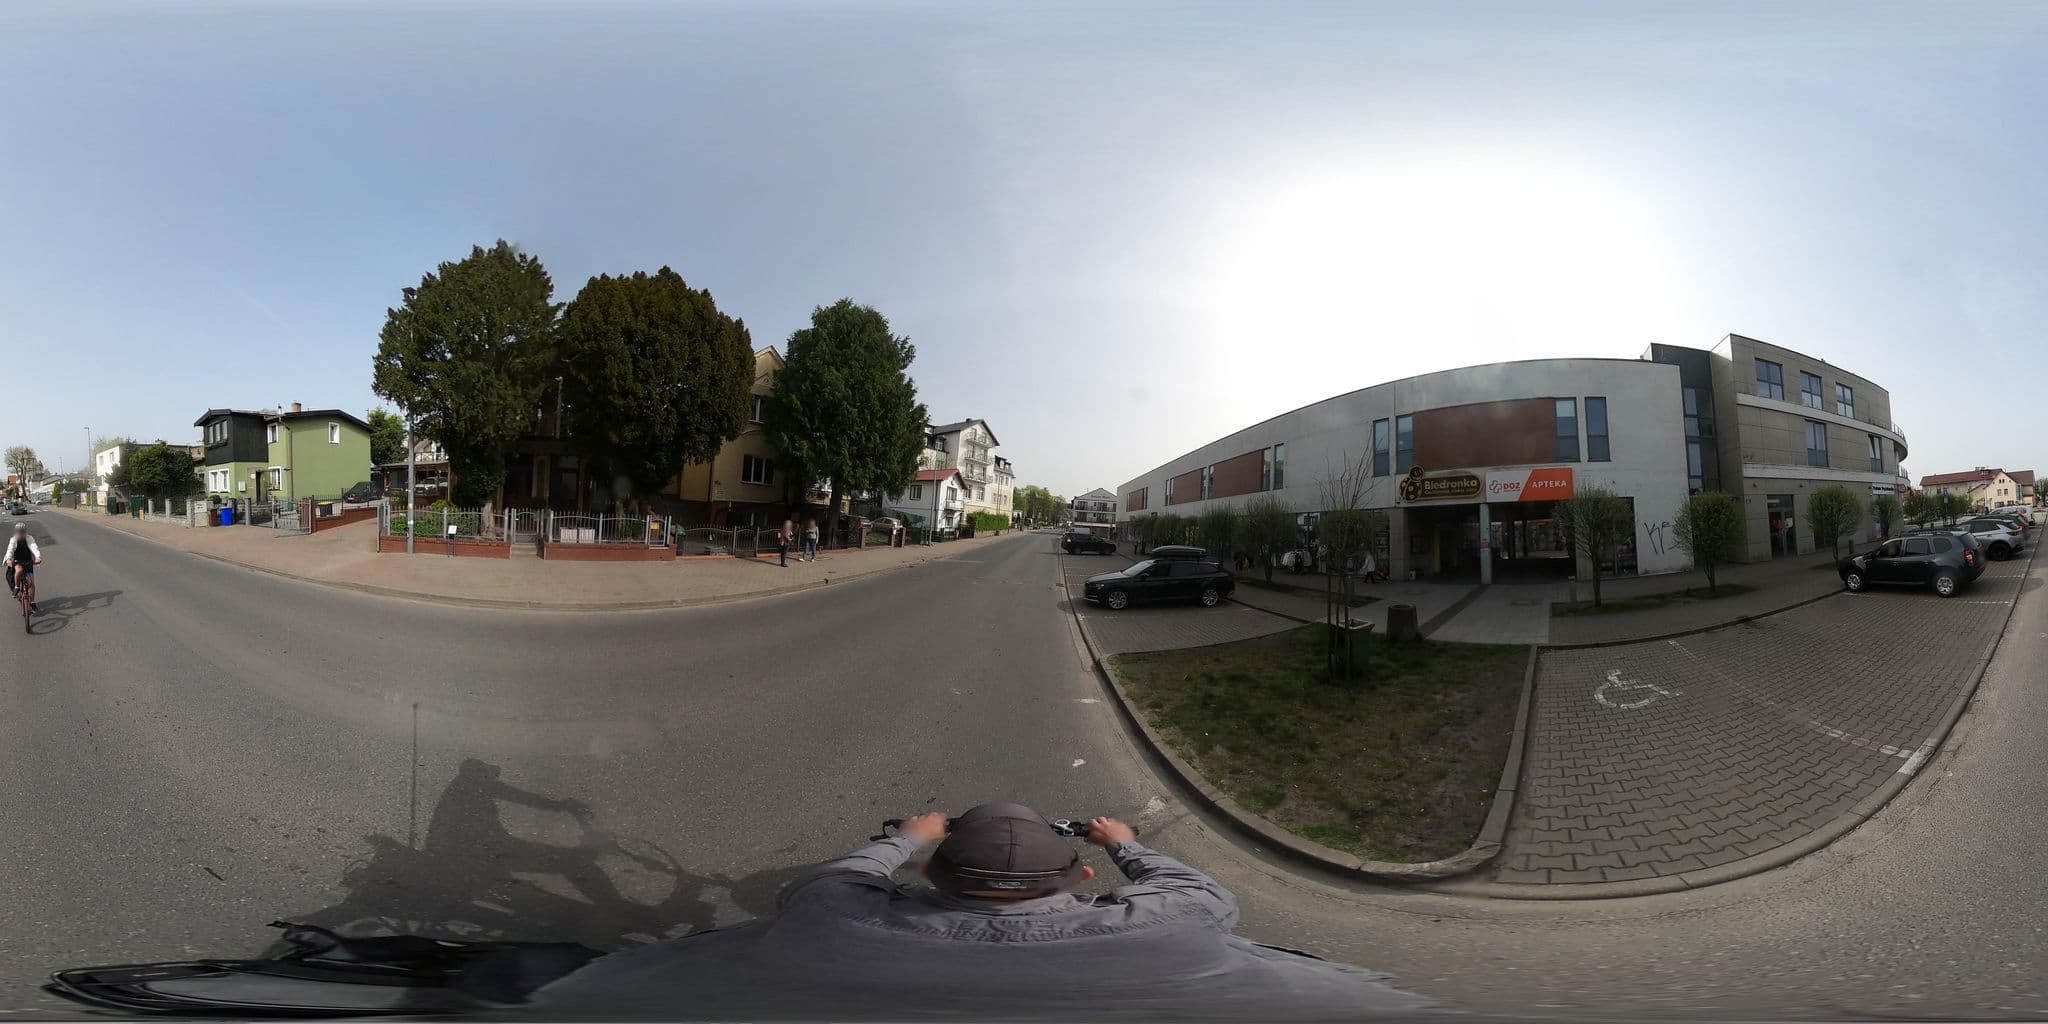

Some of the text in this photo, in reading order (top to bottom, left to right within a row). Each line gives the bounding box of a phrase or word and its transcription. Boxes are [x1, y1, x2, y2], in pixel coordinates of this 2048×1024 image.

[1424, 478, 1478, 490] Biedronka
[1503, 482, 1521, 490] DOZ
[1532, 480, 1567, 489] APTEKA
